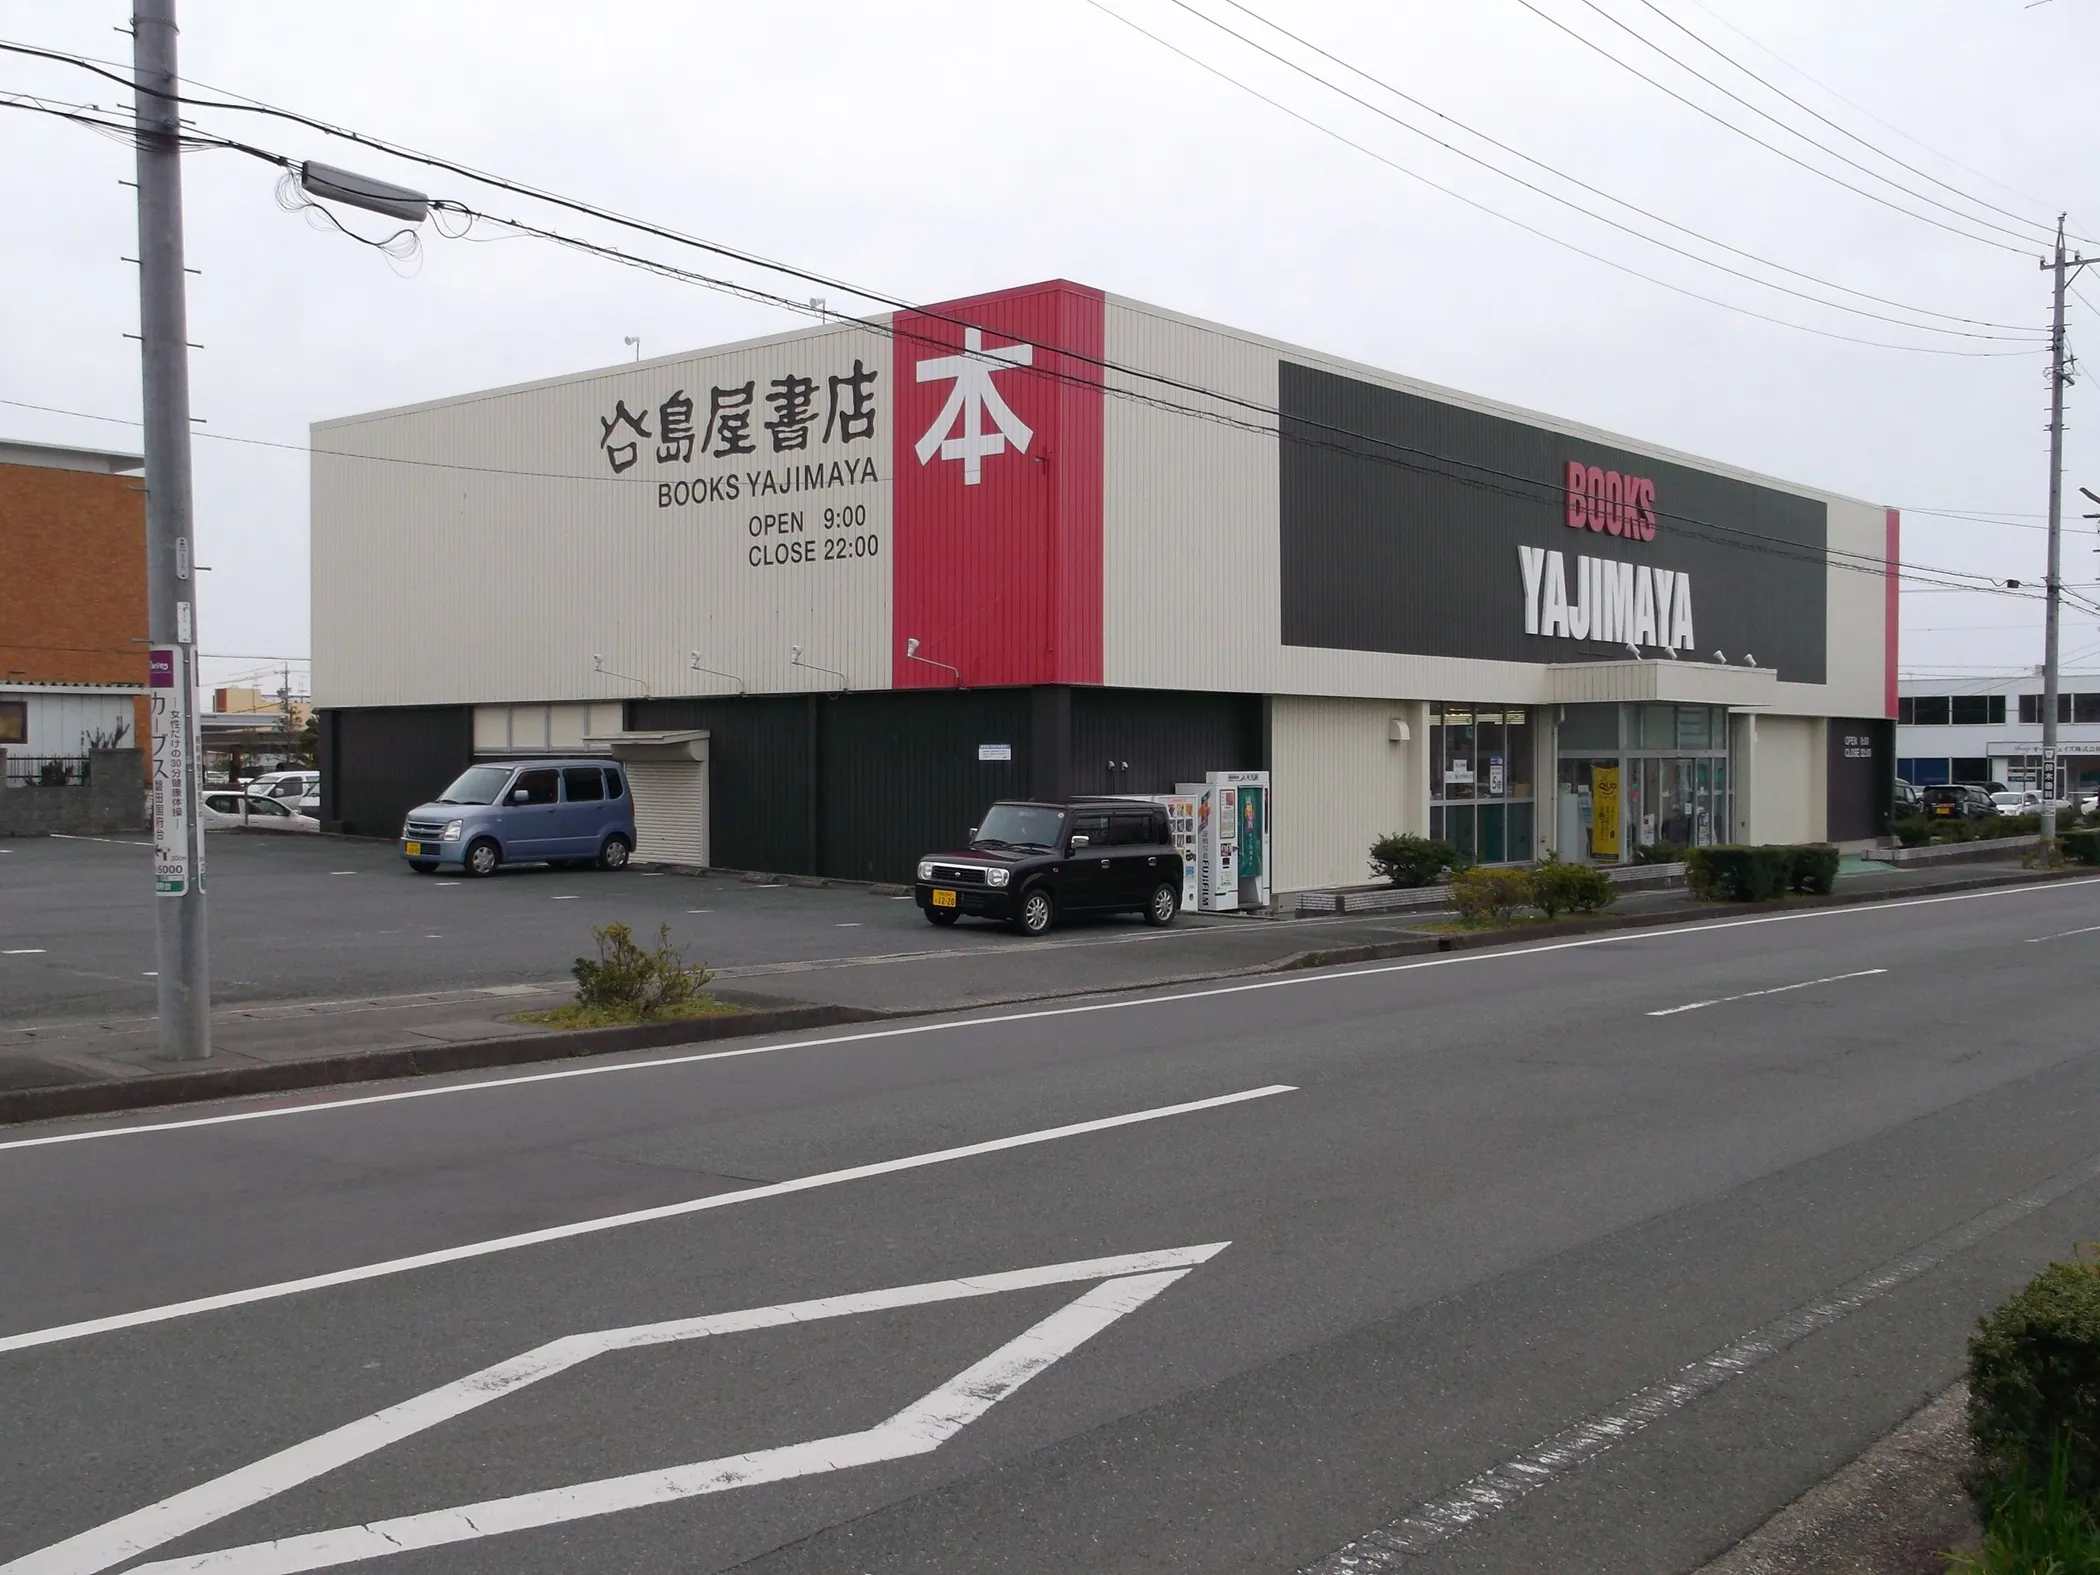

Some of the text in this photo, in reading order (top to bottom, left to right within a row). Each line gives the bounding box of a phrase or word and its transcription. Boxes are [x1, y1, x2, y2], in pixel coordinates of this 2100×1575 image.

[600, 359, 879, 474] 谷島屋書店
[914, 326, 1034, 486] 本
[658, 456, 879, 509] BOOKS YAJIMAYA
[749, 504, 867, 538] OPEN 9:00
[1565, 460, 1656, 542] BOOKS
[749, 534, 879, 568] CLOSE 22:00
[1517, 545, 1694, 650] YAJIMAYA
